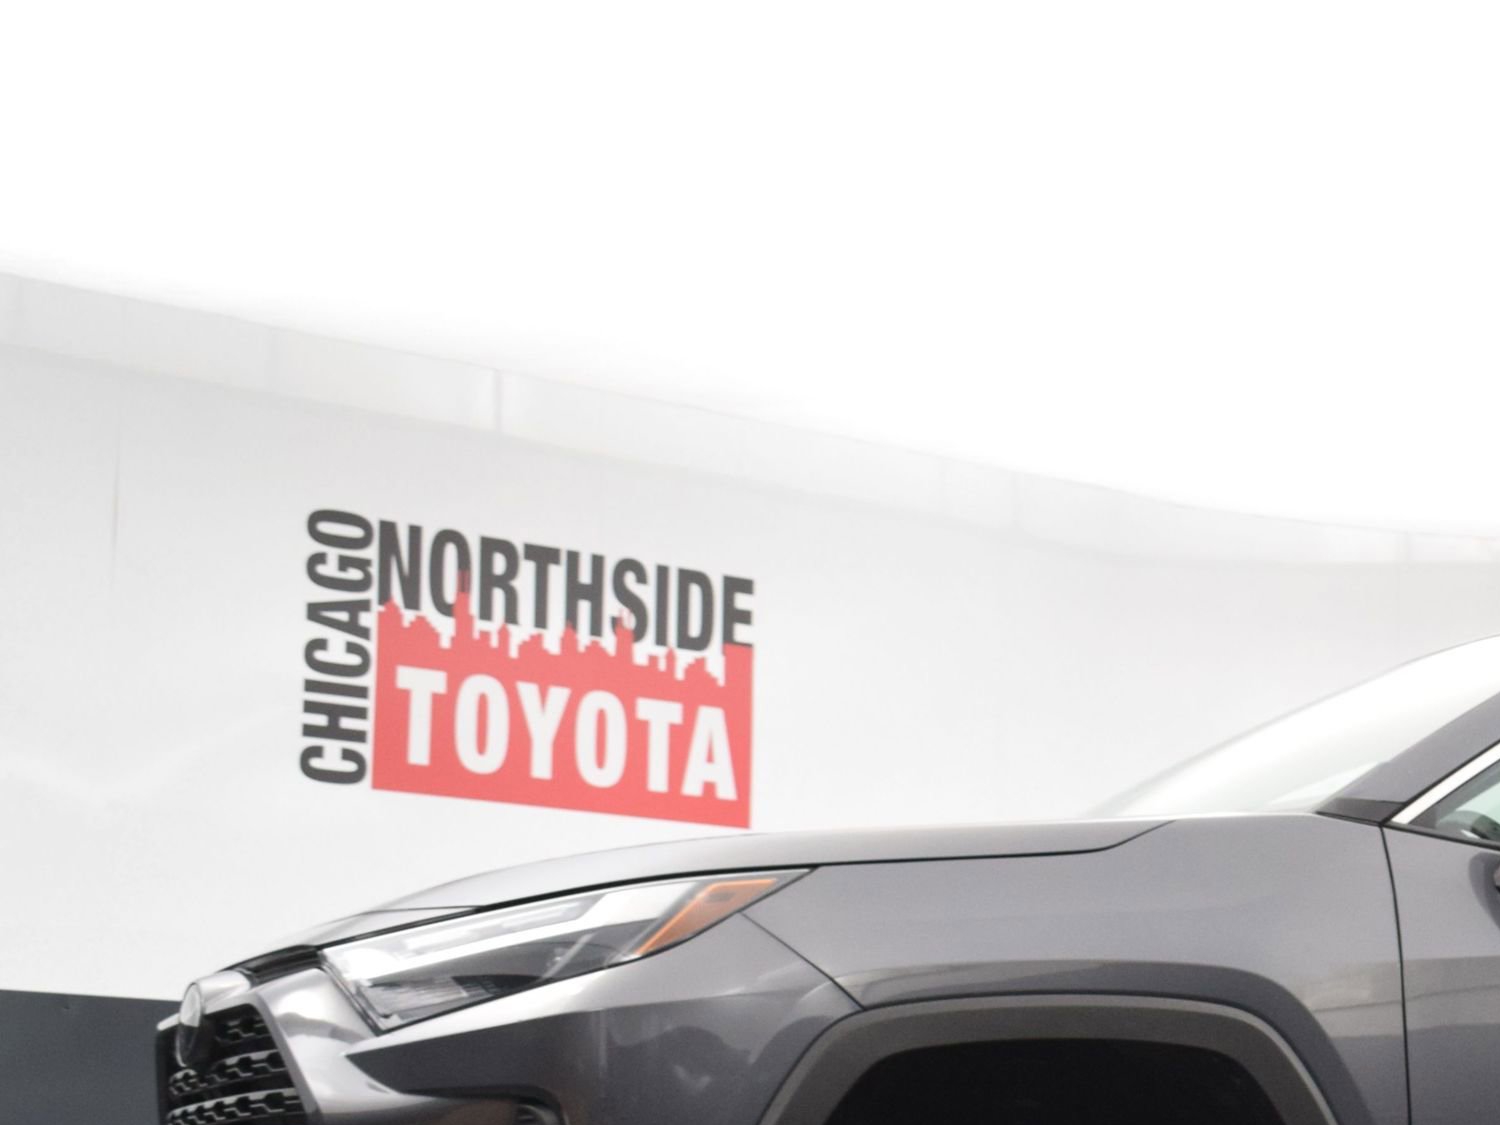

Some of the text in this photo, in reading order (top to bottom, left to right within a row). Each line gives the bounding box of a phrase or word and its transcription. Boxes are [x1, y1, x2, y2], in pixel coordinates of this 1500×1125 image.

[299, 508, 374, 785] CHICAGO
[377, 519, 754, 653] NORTHSIDE
[395, 665, 737, 801] TOYOTA
